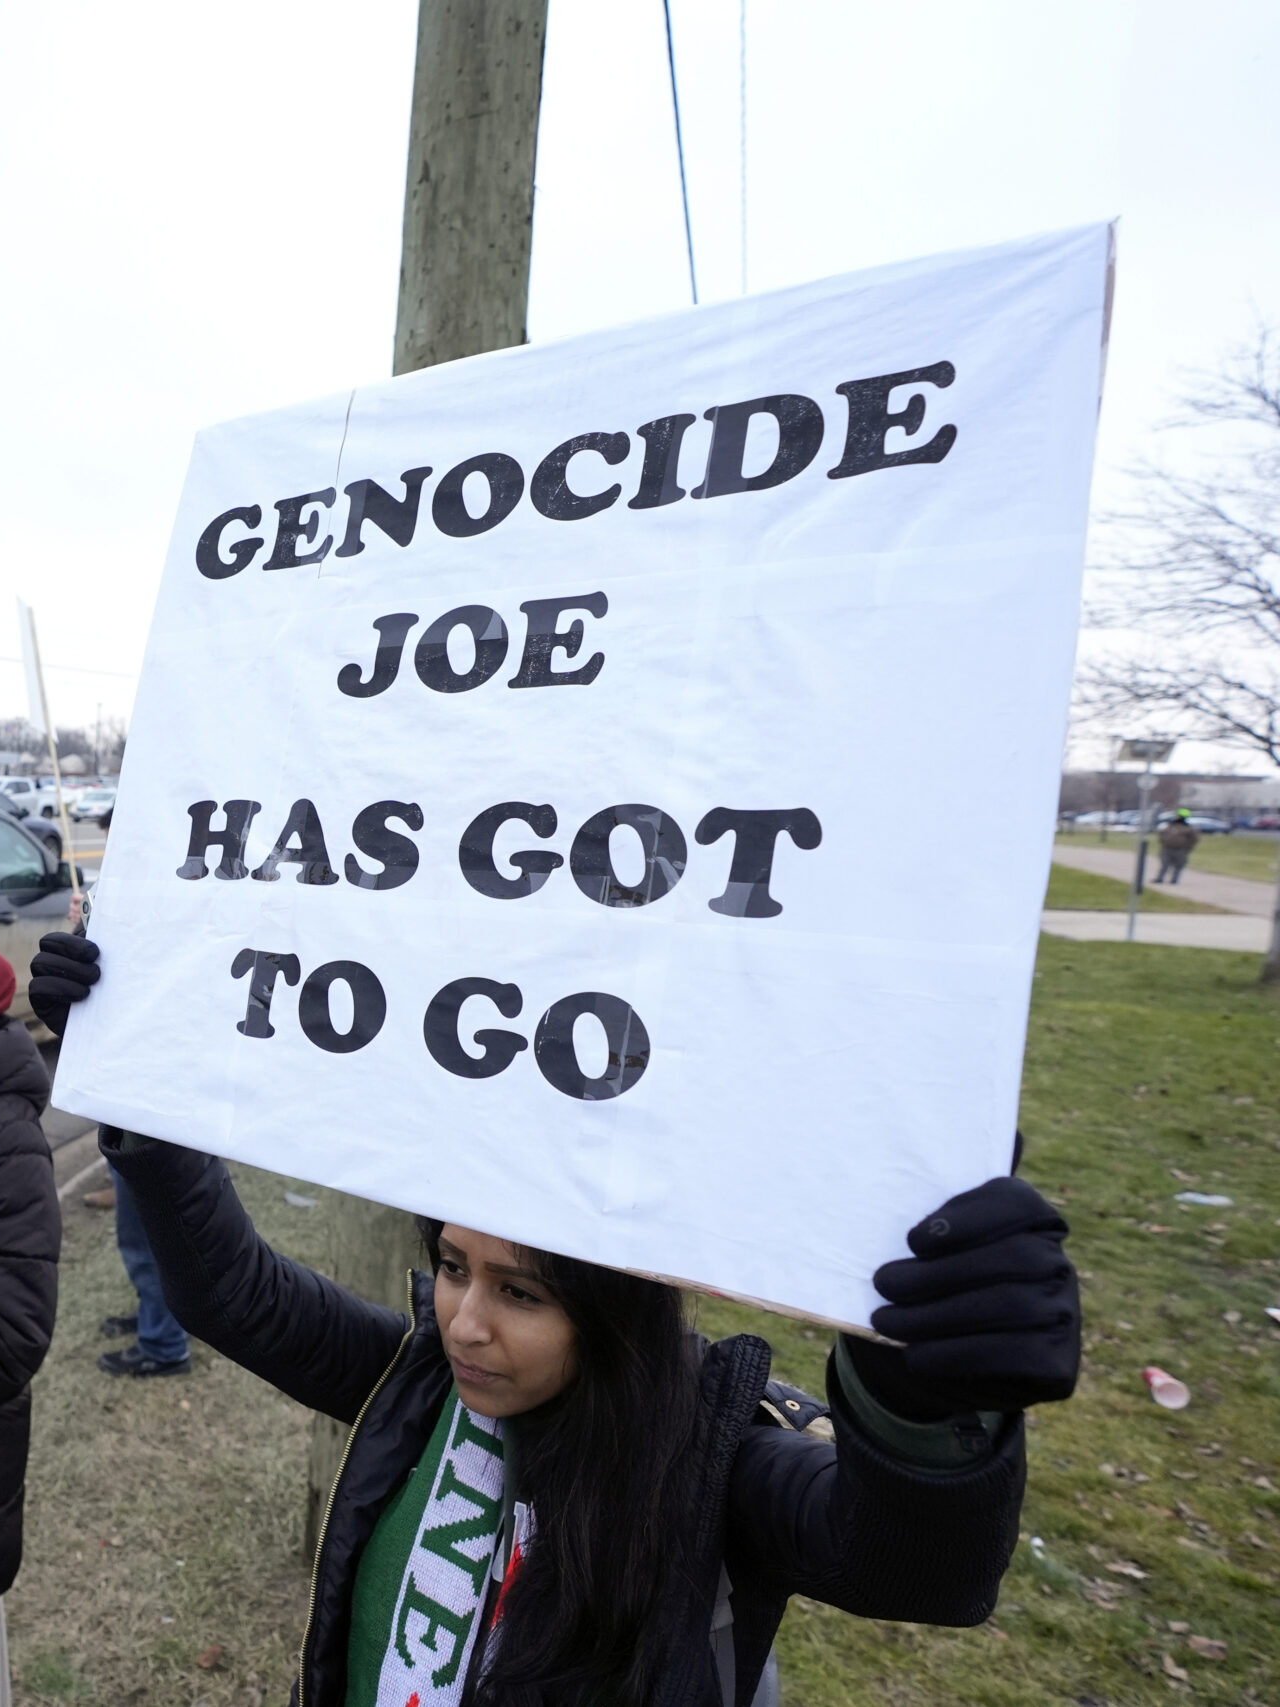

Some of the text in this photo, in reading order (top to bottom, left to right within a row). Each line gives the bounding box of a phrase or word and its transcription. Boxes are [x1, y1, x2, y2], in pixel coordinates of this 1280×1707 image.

[195, 360, 958, 580] GENOCIDE
[336, 591, 609, 698] JOE
[175, 798, 823, 919] HAS GOT
[230, 947, 651, 1101] TO GO
